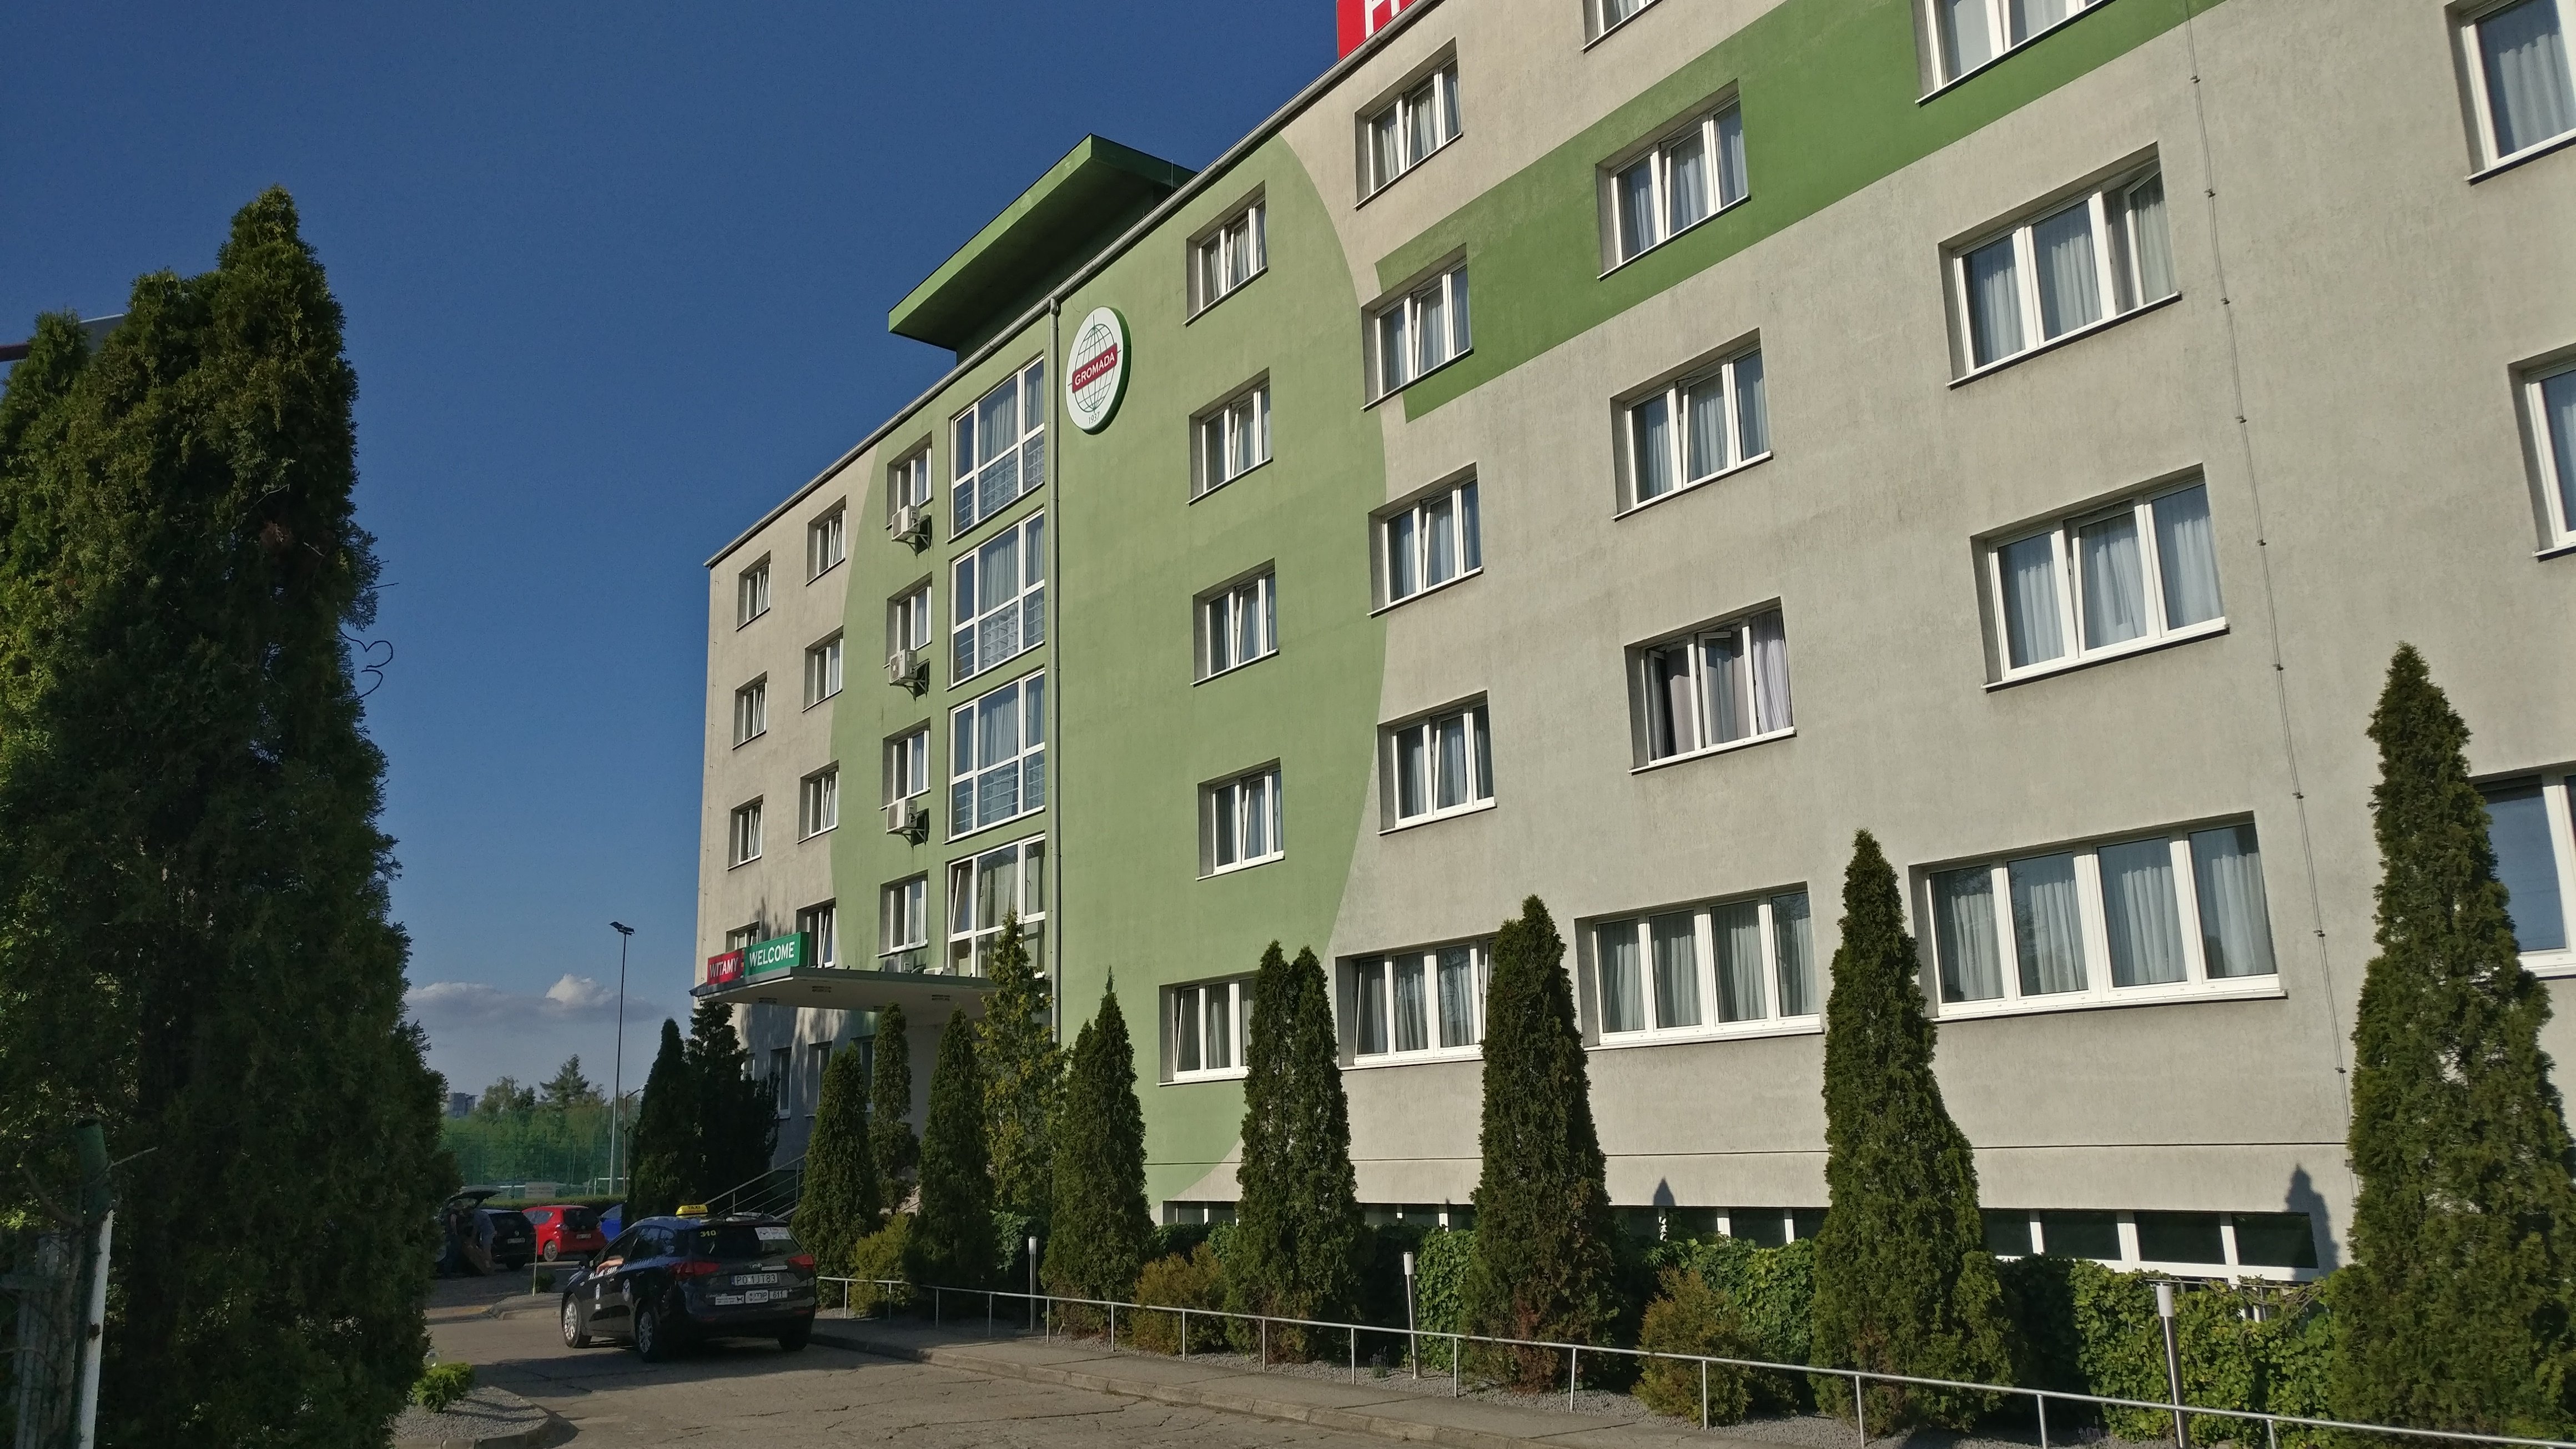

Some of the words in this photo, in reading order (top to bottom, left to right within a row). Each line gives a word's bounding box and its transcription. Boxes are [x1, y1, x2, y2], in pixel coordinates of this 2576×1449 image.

[1075, 351, 1115, 385] GROMADA
[1088, 411, 1100, 425] 1937
[749, 942, 794, 967] WELCOME
[710, 958, 738, 978] WITAMY
